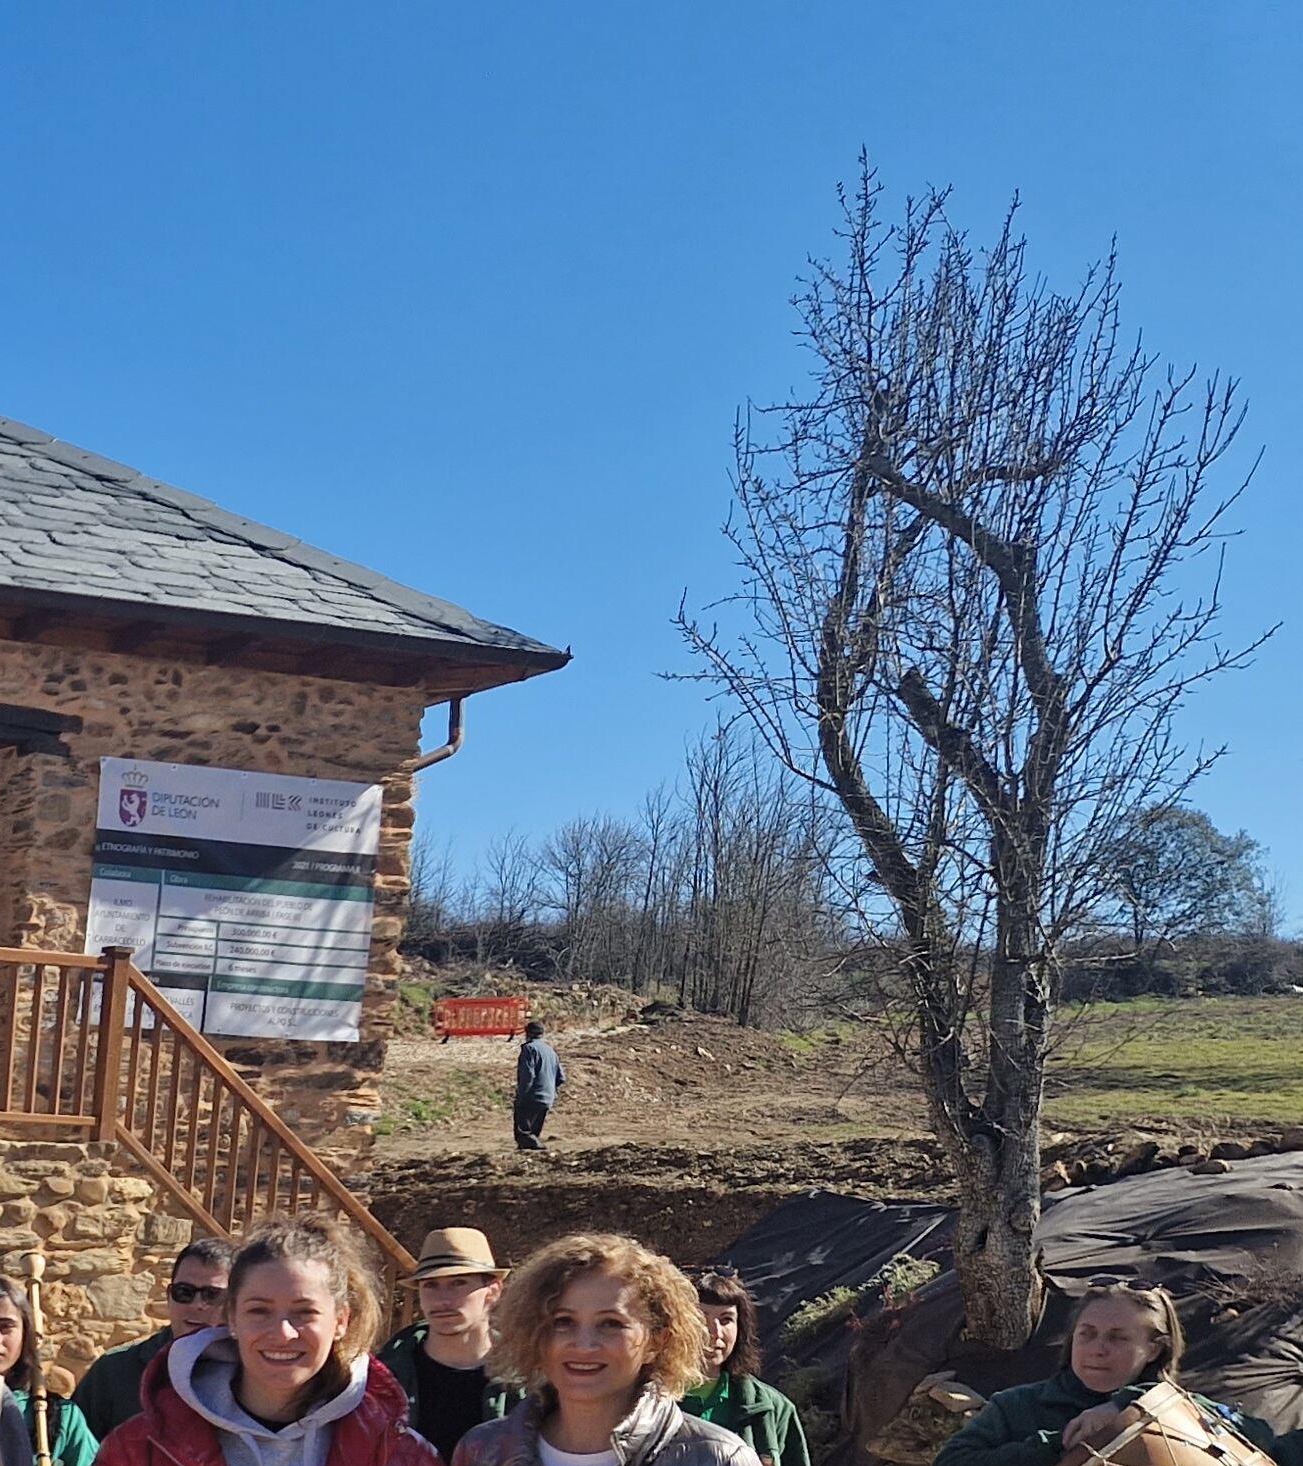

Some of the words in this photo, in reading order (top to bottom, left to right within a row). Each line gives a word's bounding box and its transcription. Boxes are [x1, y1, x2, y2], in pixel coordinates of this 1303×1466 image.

[309, 797, 357, 808] INSTITUTO
[152, 804, 166, 817] DE
[322, 824, 361, 835] CULTURA
